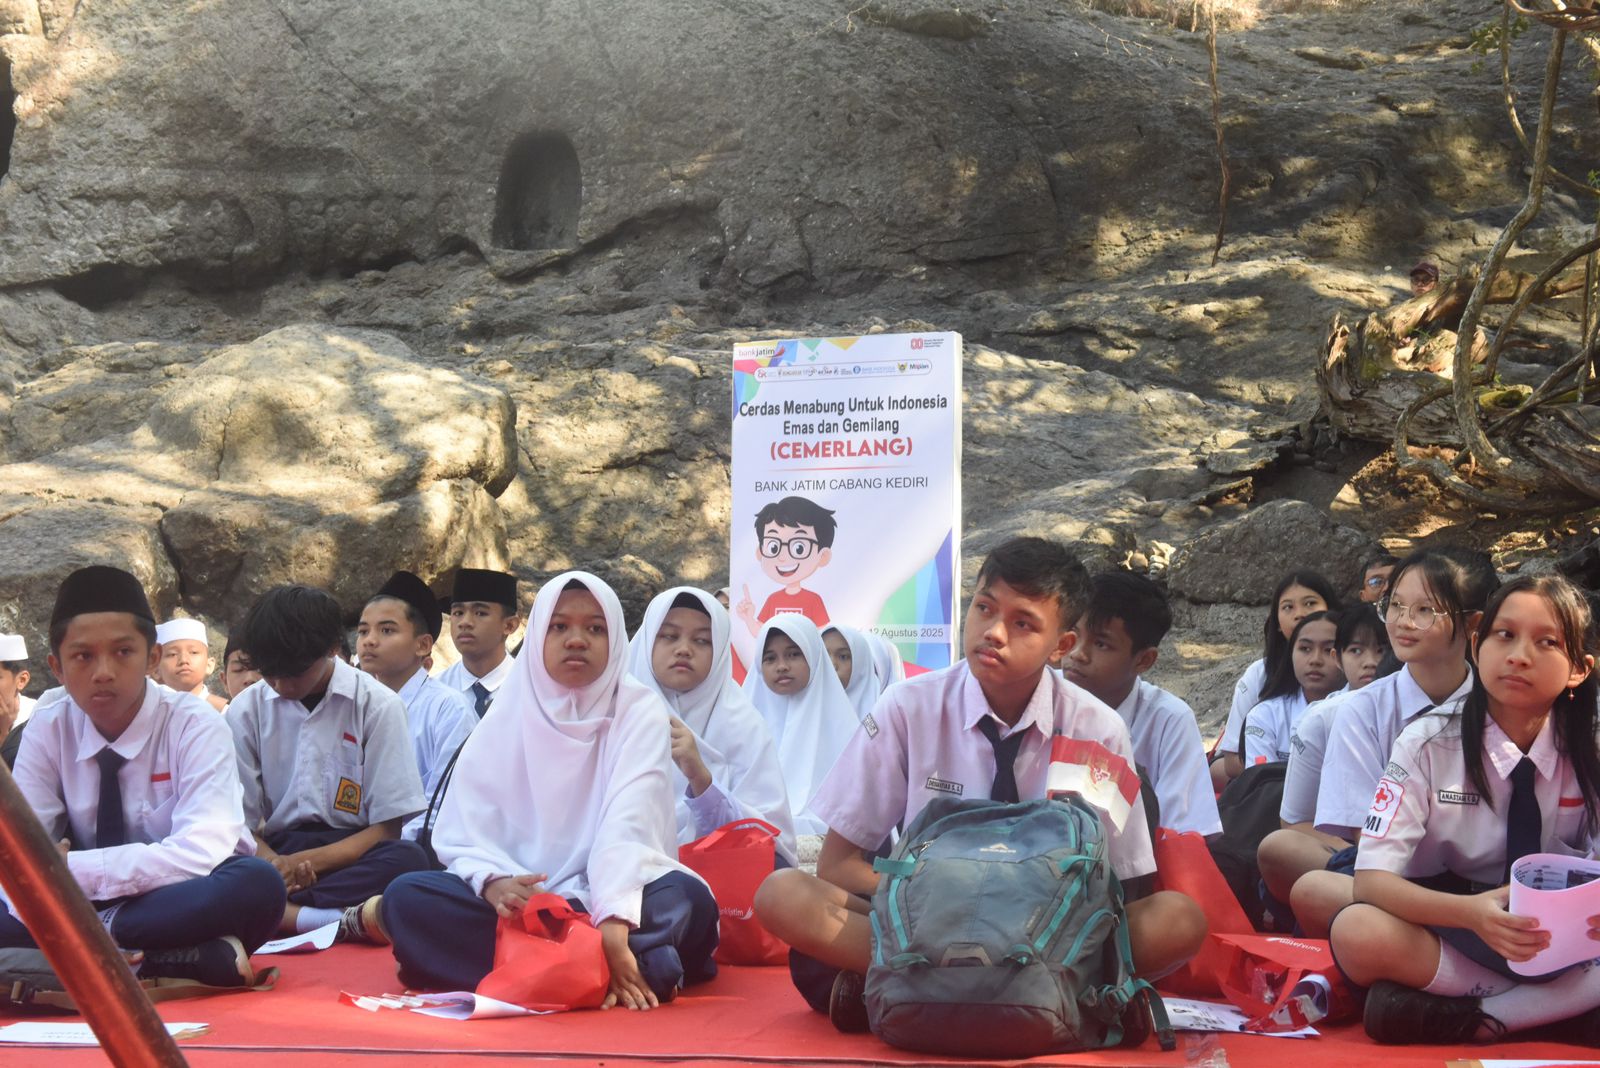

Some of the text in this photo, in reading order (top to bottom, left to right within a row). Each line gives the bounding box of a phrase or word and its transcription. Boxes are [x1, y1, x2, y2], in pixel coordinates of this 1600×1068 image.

[739, 394, 948, 416] Cerdas Menabung Untuk Indonesia
[783, 417, 899, 435] Emas dan Gemilang
[770, 437, 913, 461] (CEMERLANG)
[755, 476, 928, 493] BANK JATIM CABANG KEDIRI
[881, 628, 918, 639] Agustus
[920, 627, 944, 638] 2025
